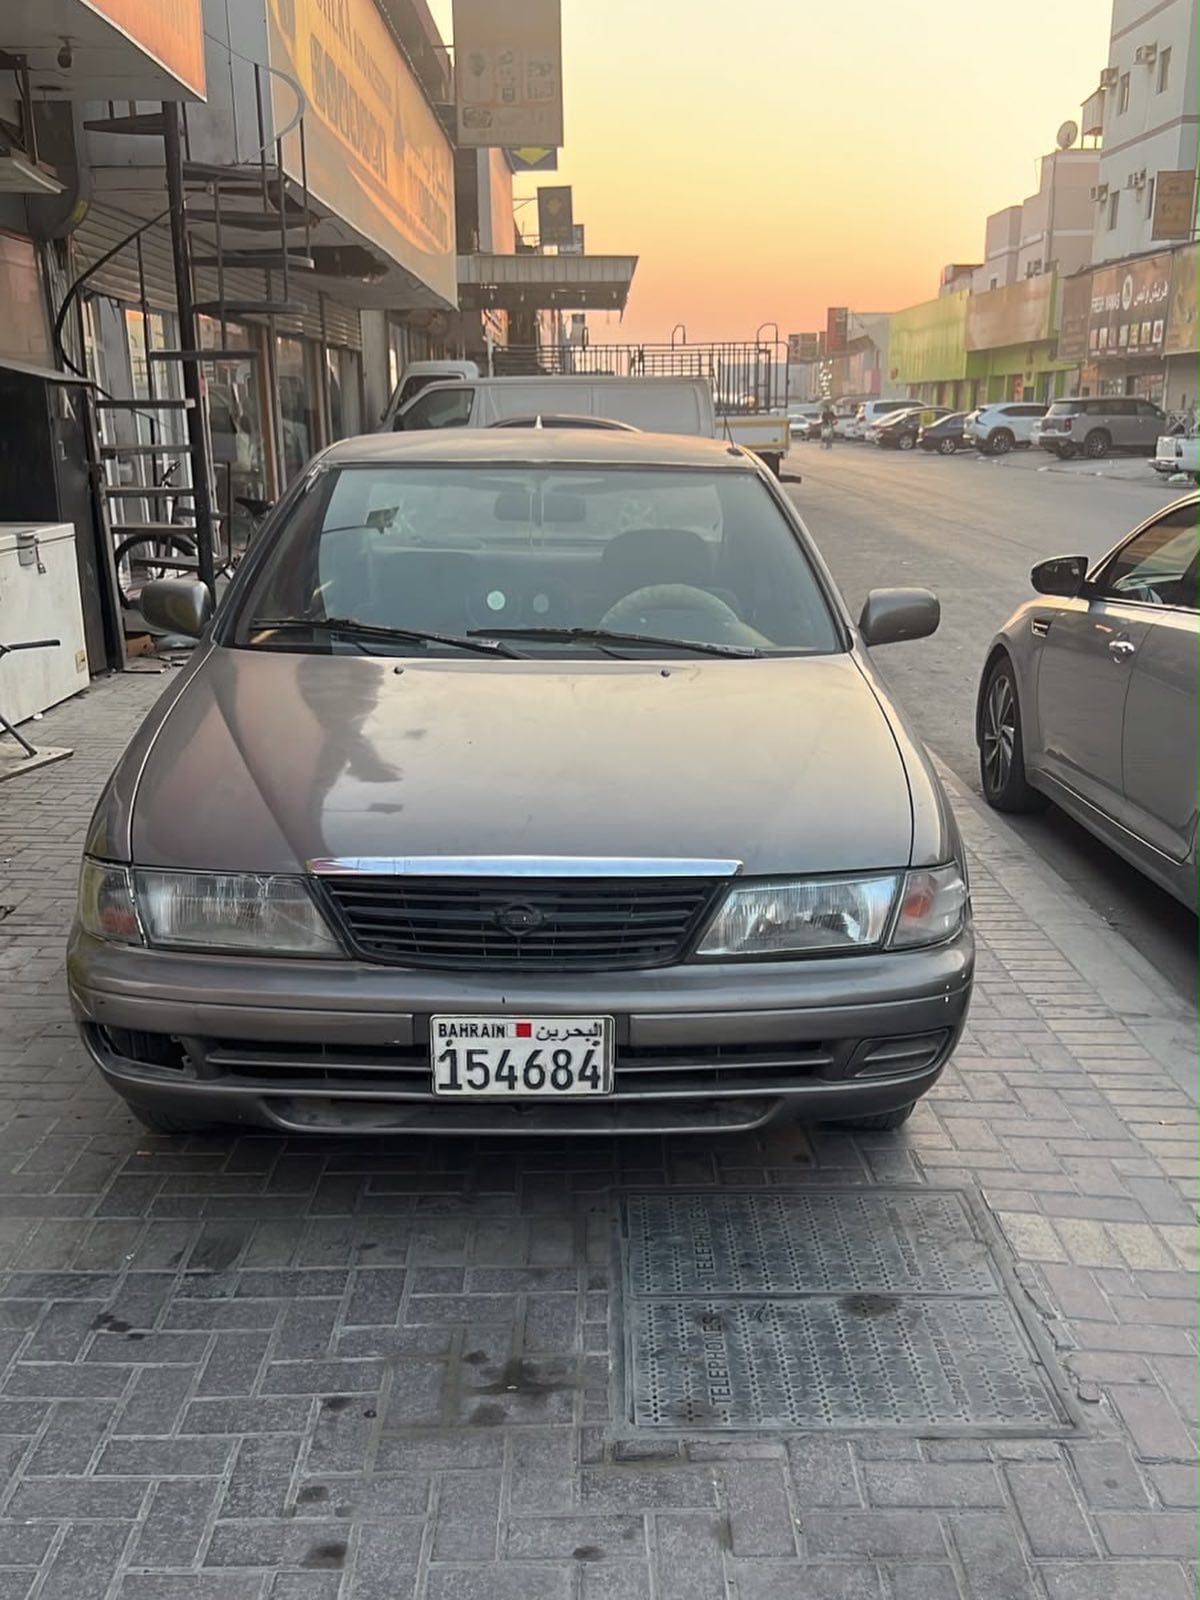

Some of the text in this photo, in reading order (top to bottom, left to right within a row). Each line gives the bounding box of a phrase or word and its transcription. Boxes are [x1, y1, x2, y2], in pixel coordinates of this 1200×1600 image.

[438, 1023, 505, 1038] BAHRAIN
[535, 1022, 603, 1041] البحرين
[438, 1049, 601, 1091] 154684
[702, 1314, 732, 1406] TELEPHONES
